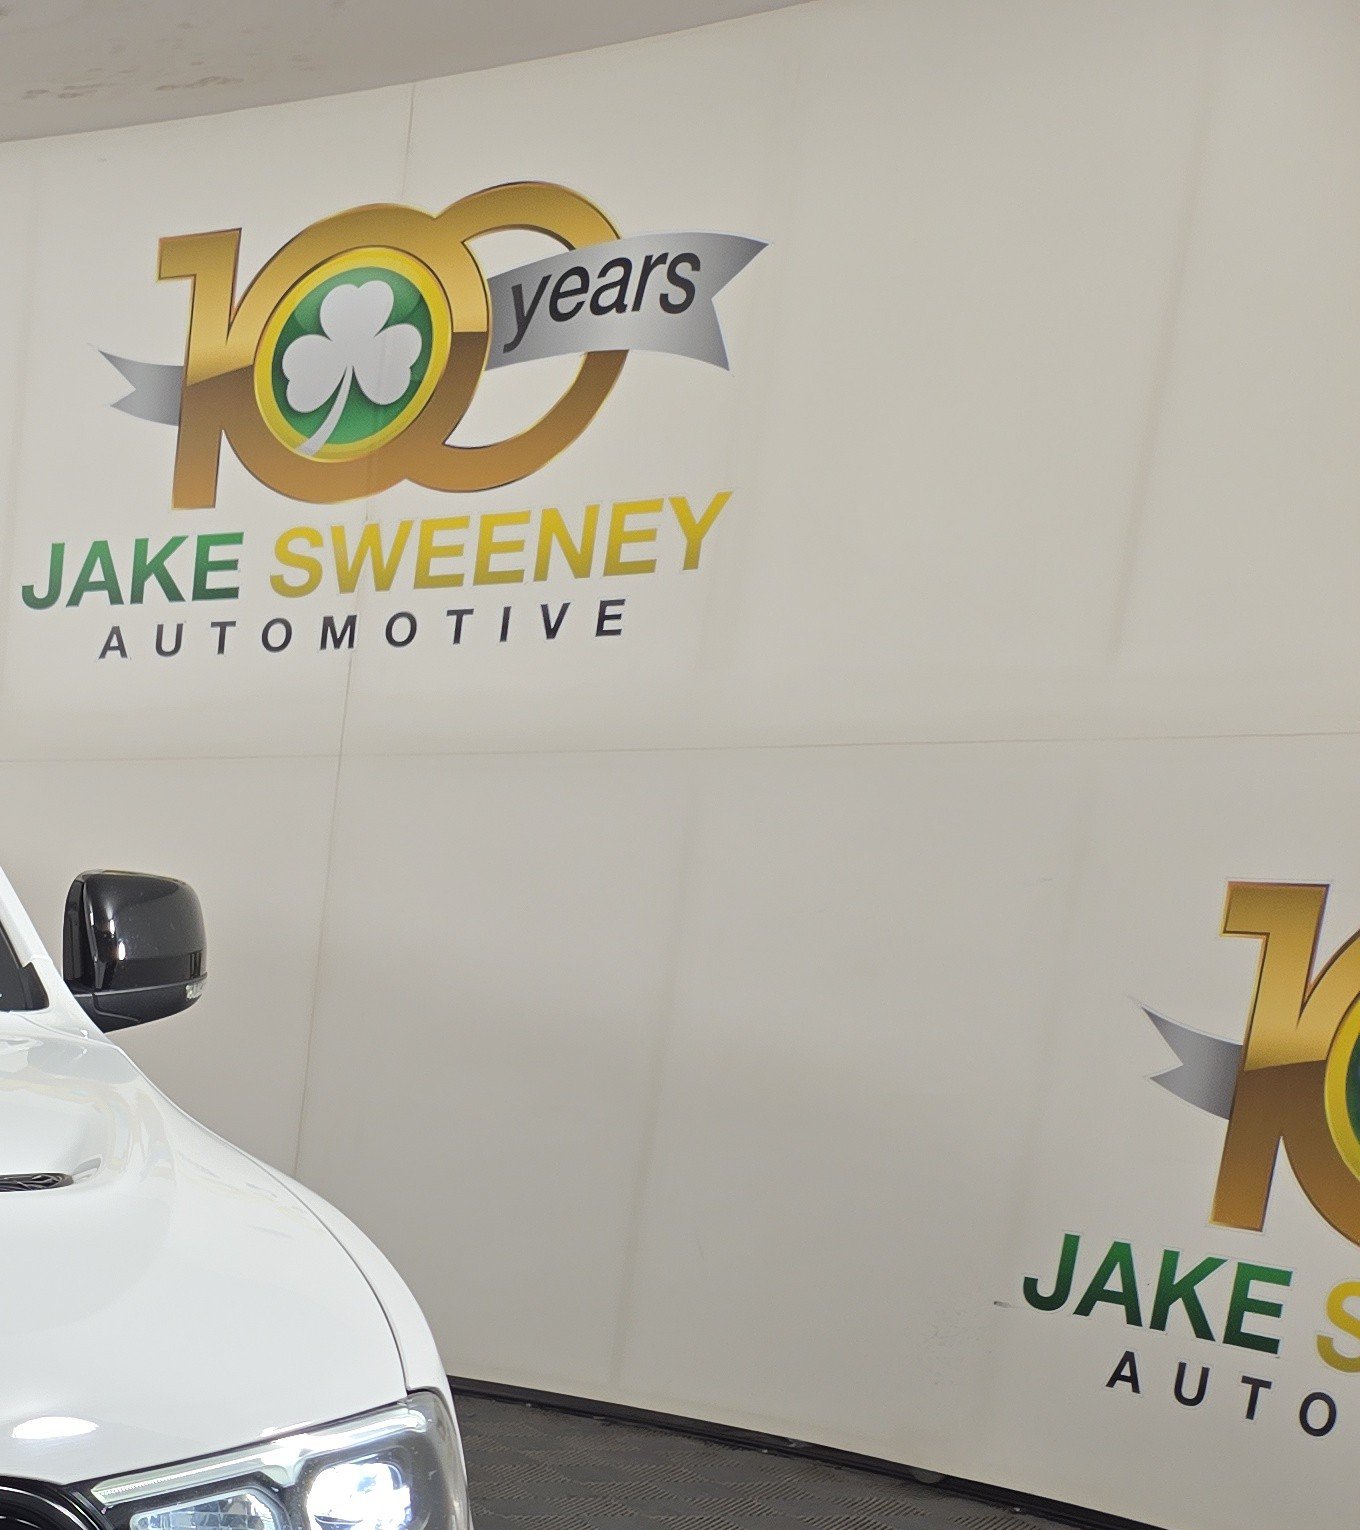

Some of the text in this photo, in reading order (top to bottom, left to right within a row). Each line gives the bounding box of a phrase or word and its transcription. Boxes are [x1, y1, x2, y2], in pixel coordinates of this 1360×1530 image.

[503, 251, 701, 354] years
[21, 491, 732, 610] JAKE SWEENEY
[99, 598, 626, 661] AUTOMOTIVE
[1023, 1233, 1293, 1354] JAKE
[1105, 1350, 1337, 1437] AUTO
